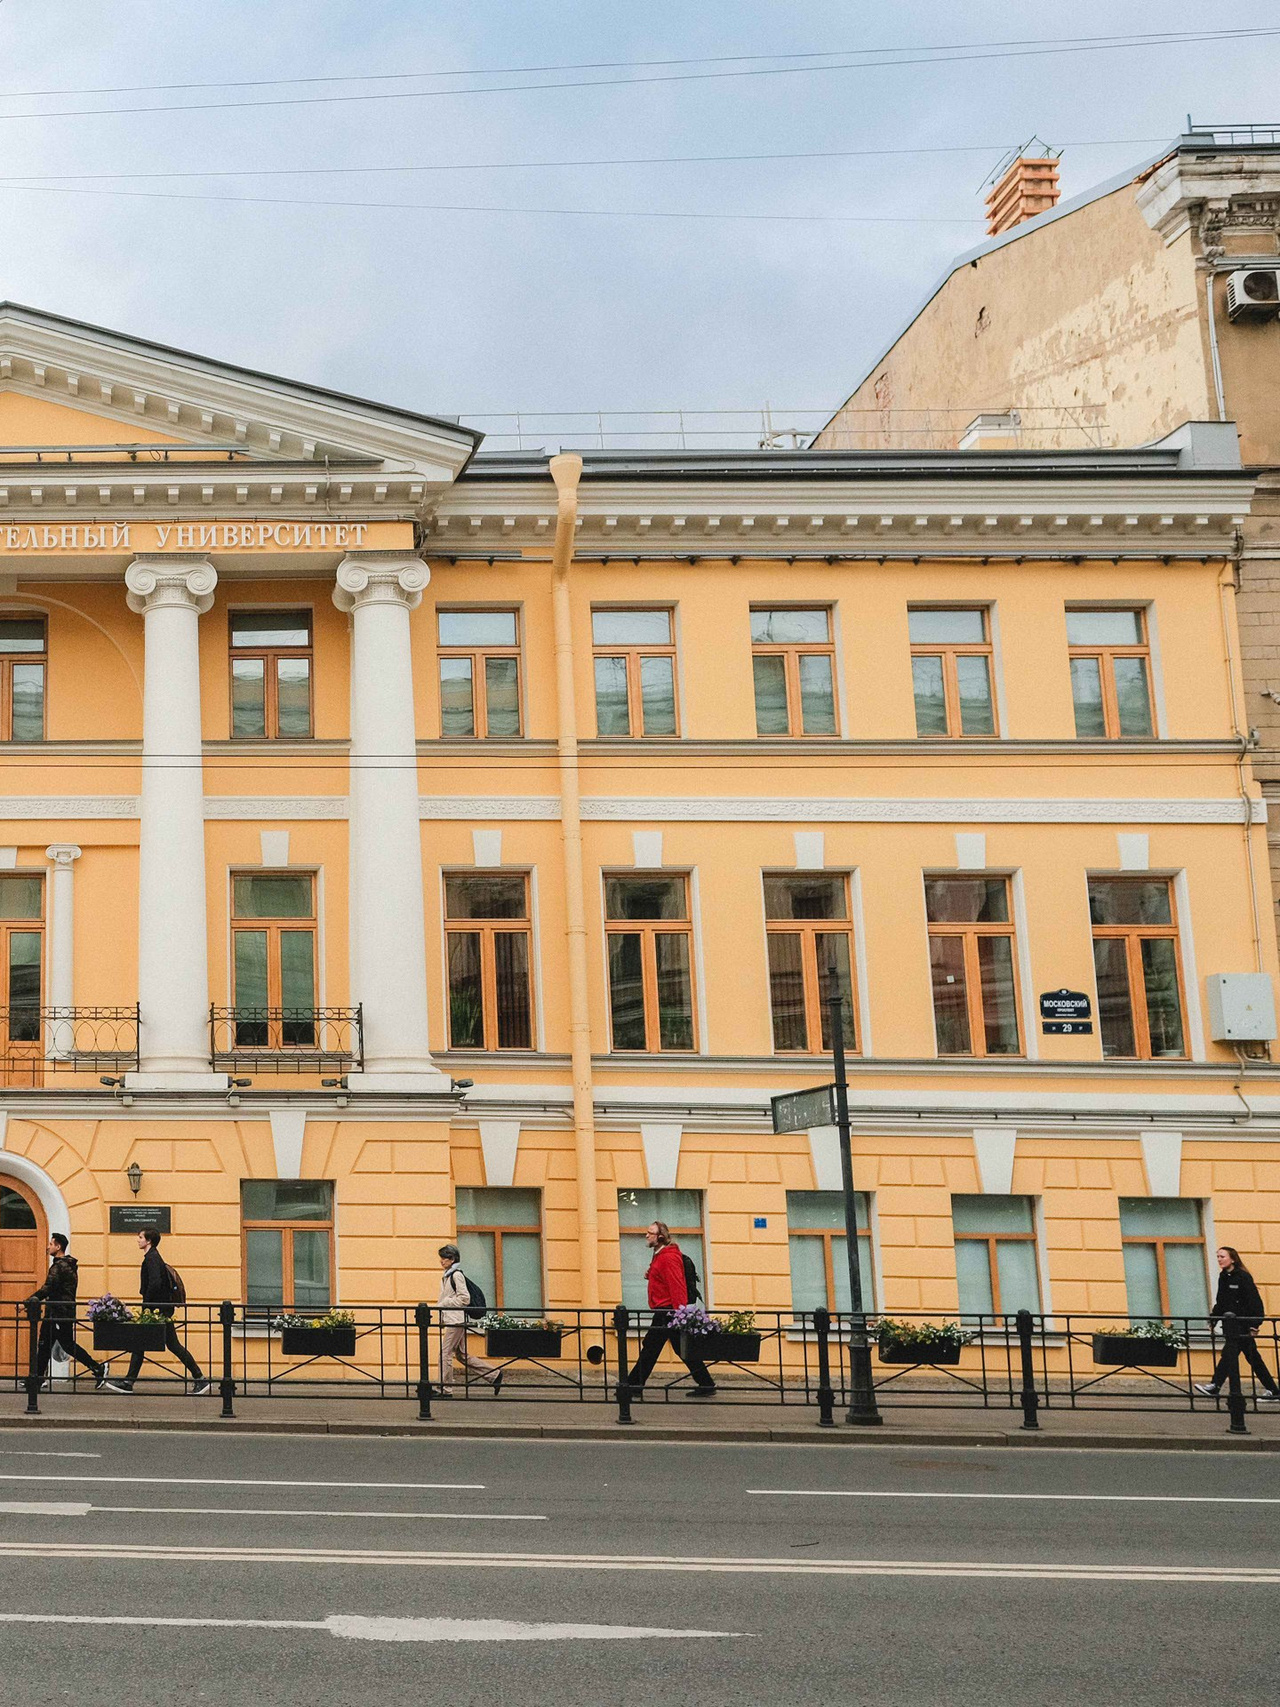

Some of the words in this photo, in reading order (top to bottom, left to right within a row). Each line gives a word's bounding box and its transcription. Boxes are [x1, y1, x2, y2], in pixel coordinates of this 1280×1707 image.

[156, 523, 368, 547] УНИВЕРСИТЕТ
[1043, 999, 1088, 1008] МОСКОВСКИЙ
[1062, 1024, 1073, 1033] 29
